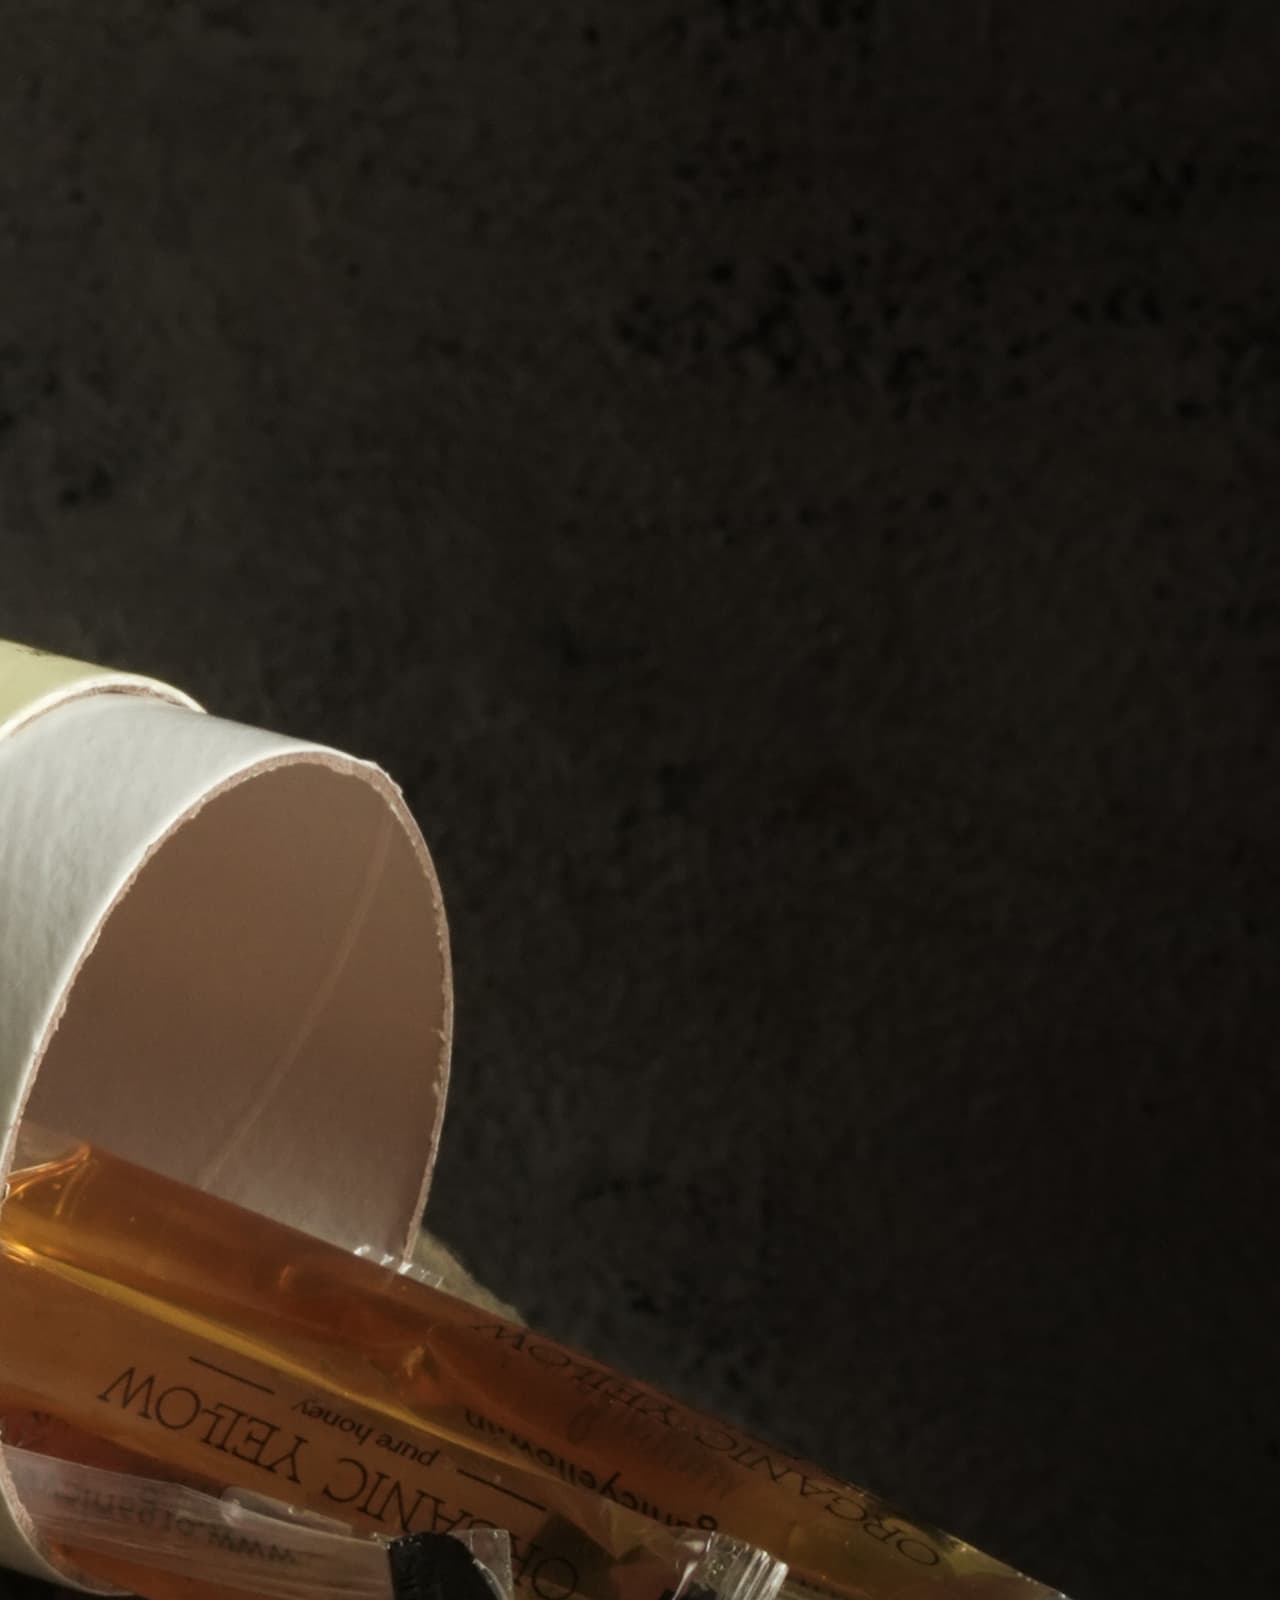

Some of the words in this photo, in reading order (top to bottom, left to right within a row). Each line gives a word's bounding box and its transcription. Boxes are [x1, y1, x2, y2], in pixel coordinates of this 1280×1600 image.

[97, 1366, 308, 1485] YELLOW
[292, 1401, 374, 1451] honey
[471, 1318, 678, 1429] YELLOW
[364, 1431, 441, 1467] pure
[694, 1430, 941, 1571] ORGANIC
